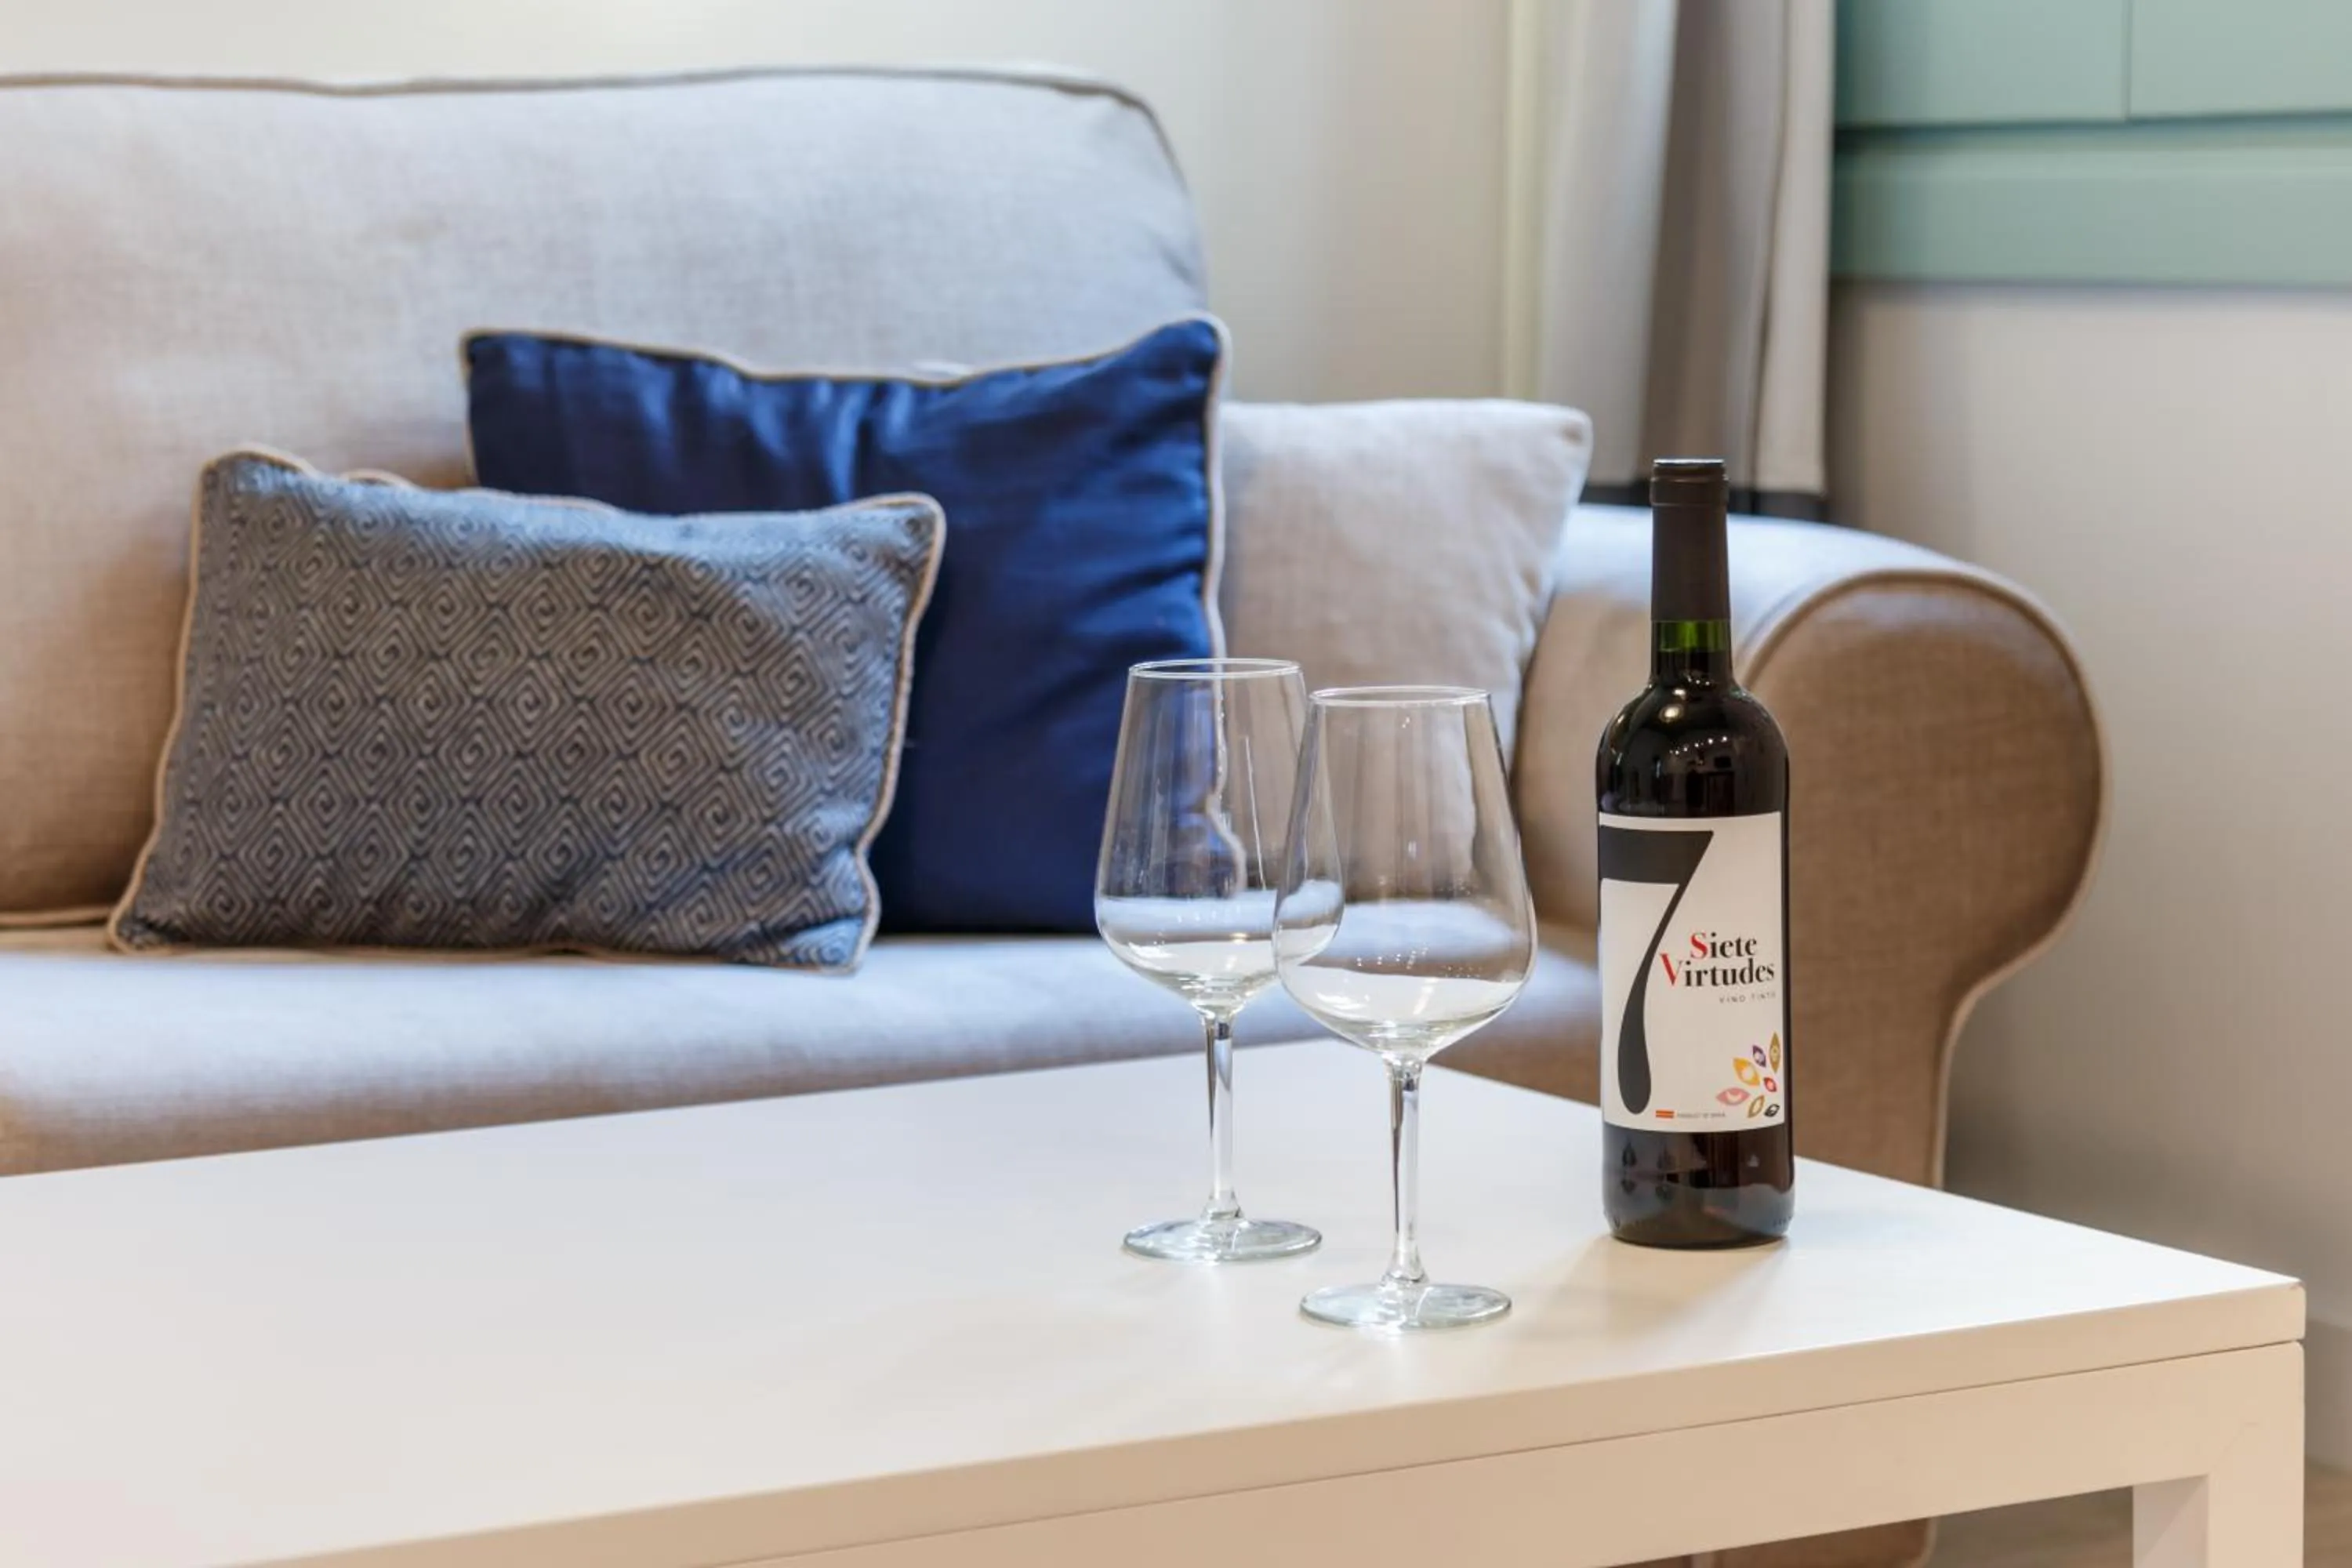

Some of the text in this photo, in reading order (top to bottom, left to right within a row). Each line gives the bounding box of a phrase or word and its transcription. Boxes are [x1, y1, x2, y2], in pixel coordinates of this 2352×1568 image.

[1690, 931, 1757, 959] Siete
[1598, 825, 1714, 1115] 7
[1660, 953, 1775, 986] Virtudes
[1719, 995, 1746, 1004] VINO
